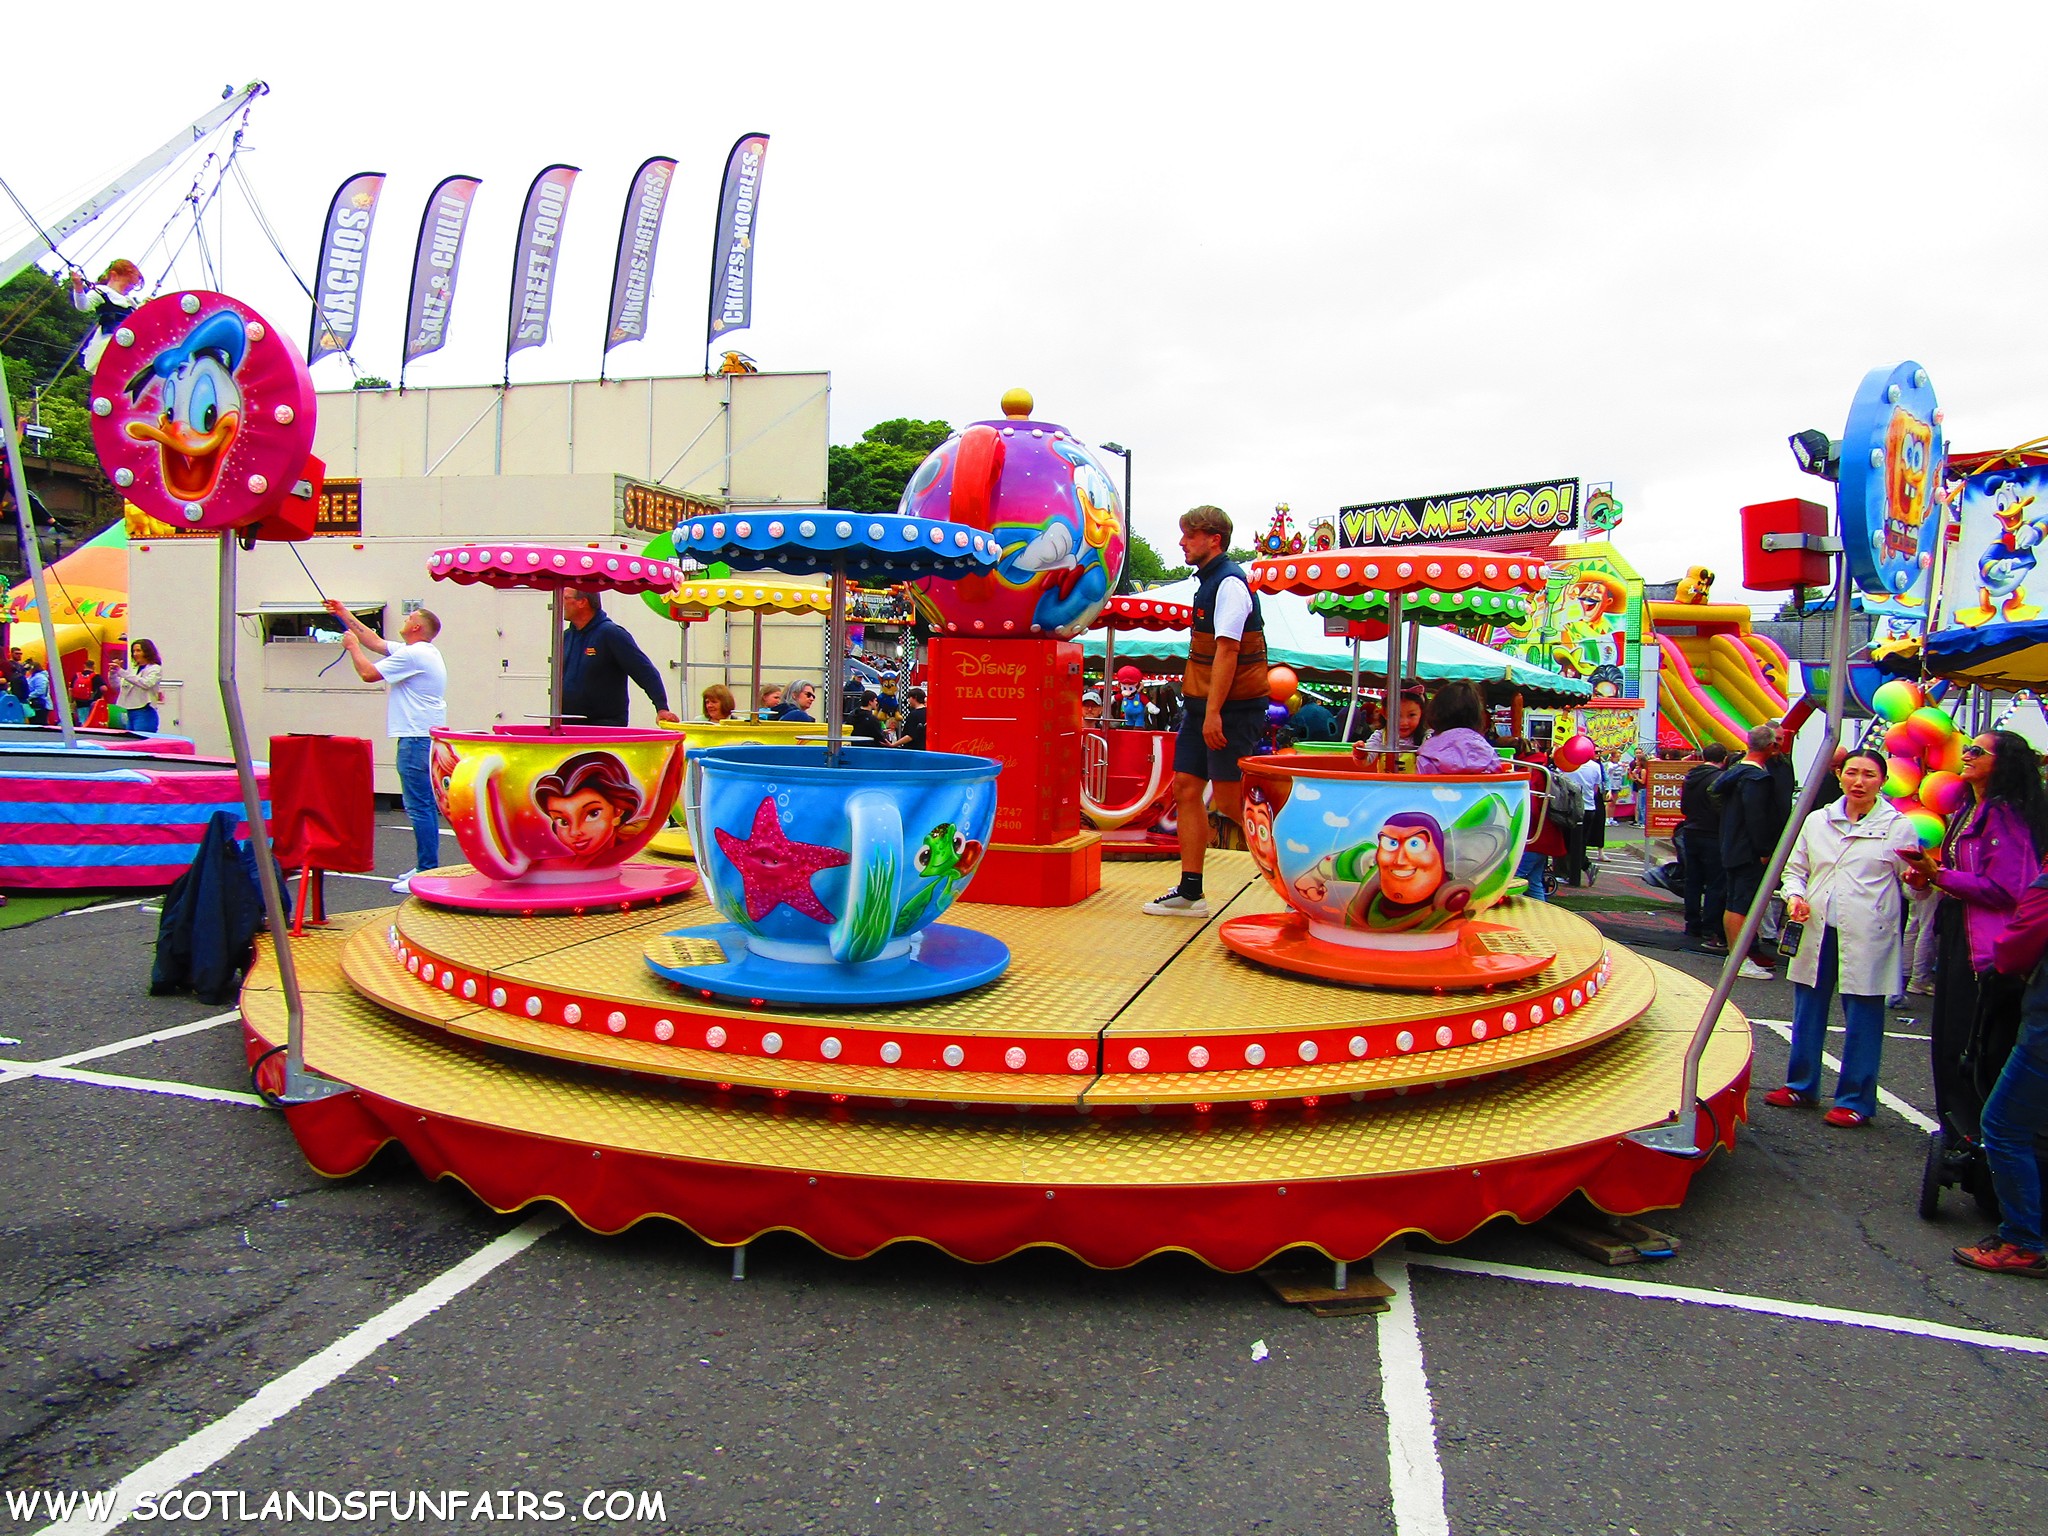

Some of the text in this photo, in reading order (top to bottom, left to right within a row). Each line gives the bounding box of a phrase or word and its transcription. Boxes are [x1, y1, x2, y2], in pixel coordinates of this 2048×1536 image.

[430, 195, 466, 270] CHILLI
[517, 181, 566, 340] STREET FOOD
[722, 152, 759, 324] CHINESE NOODLES
[321, 208, 370, 333] NACHOS
[414, 293, 448, 346] SALT
[625, 487, 683, 531] STREET
[1341, 484, 1575, 547] VIVA MEXICO!
[955, 686, 1025, 699] TEA CUPS
[1653, 785, 1682, 796] Pick
